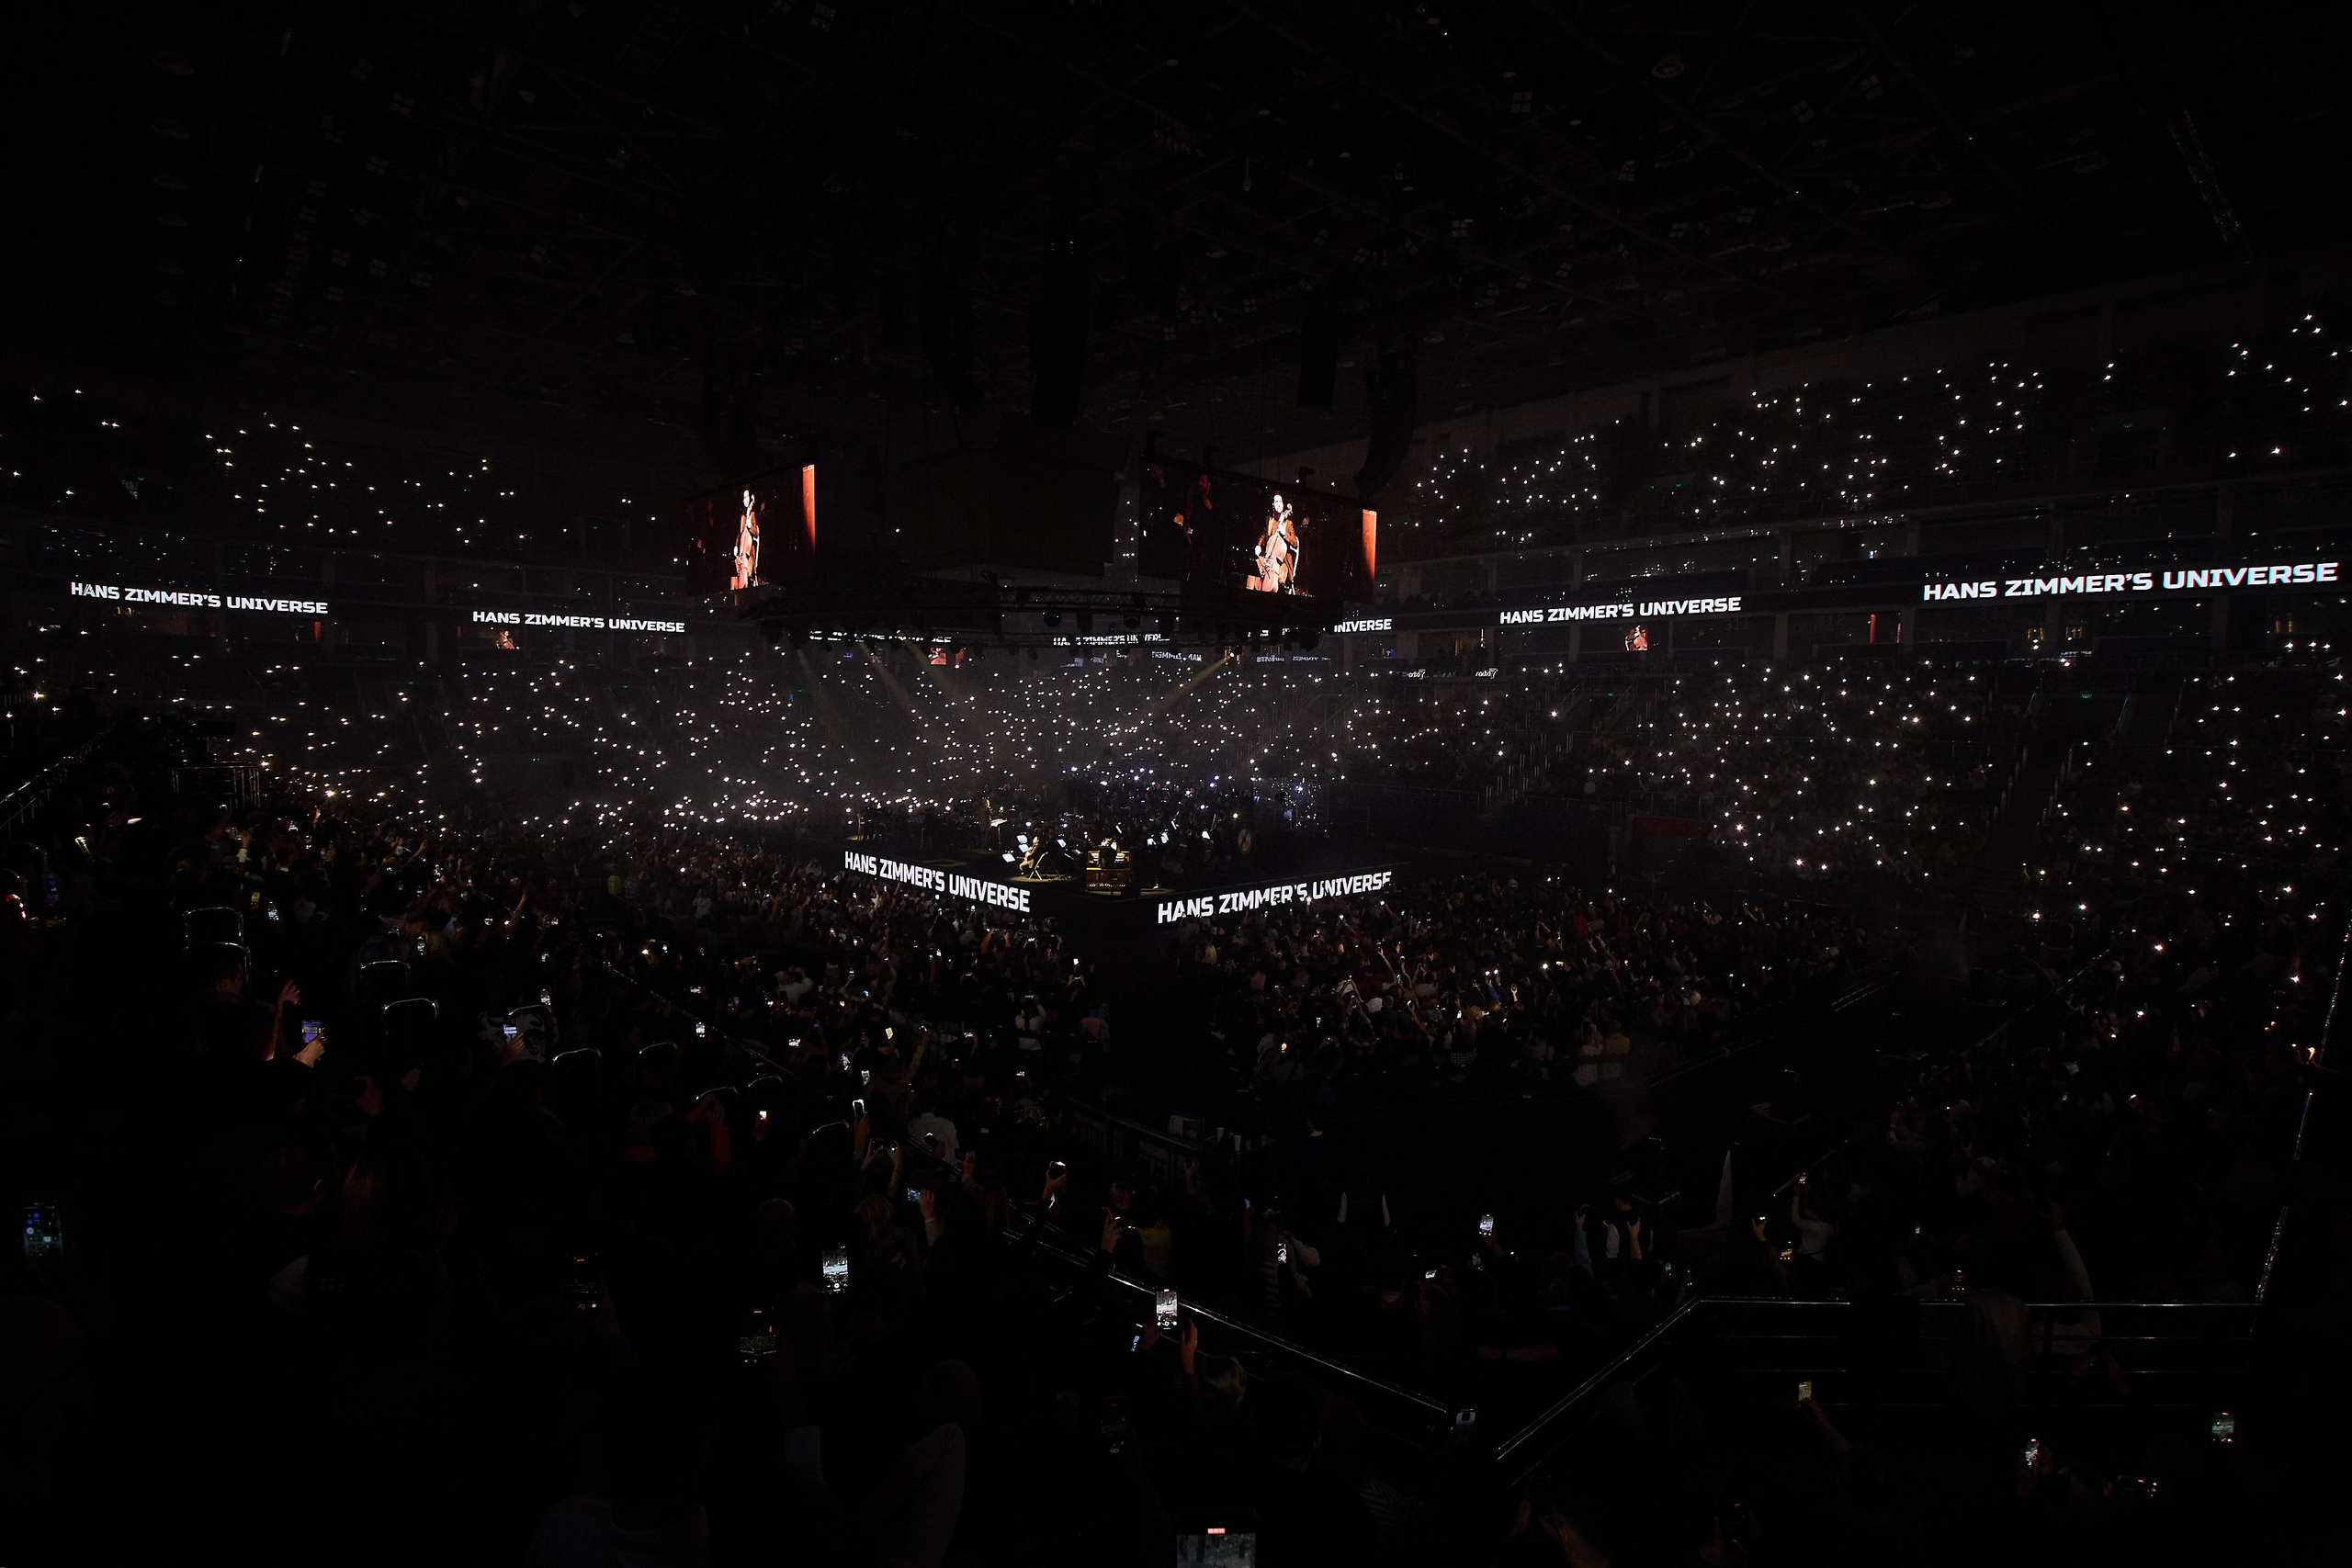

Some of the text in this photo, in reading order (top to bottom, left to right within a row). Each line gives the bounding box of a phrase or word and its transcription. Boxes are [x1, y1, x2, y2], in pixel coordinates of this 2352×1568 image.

[71, 581, 329, 615] HANS ZIMMER'S UNIVERSE
[1923, 562, 2340, 601] HANS ZIMMER'S UNIVERSE
[472, 611, 685, 633] HANS ZIMMER'S UNIVERSE
[1499, 596, 1742, 625] HANS ZIMMER'S UNIVERSE
[844, 851, 1031, 913] HANS ZIMMER'S UNIVERSE
[1158, 871, 1392, 924] HANS ZIMMER'S UNIVERSE
